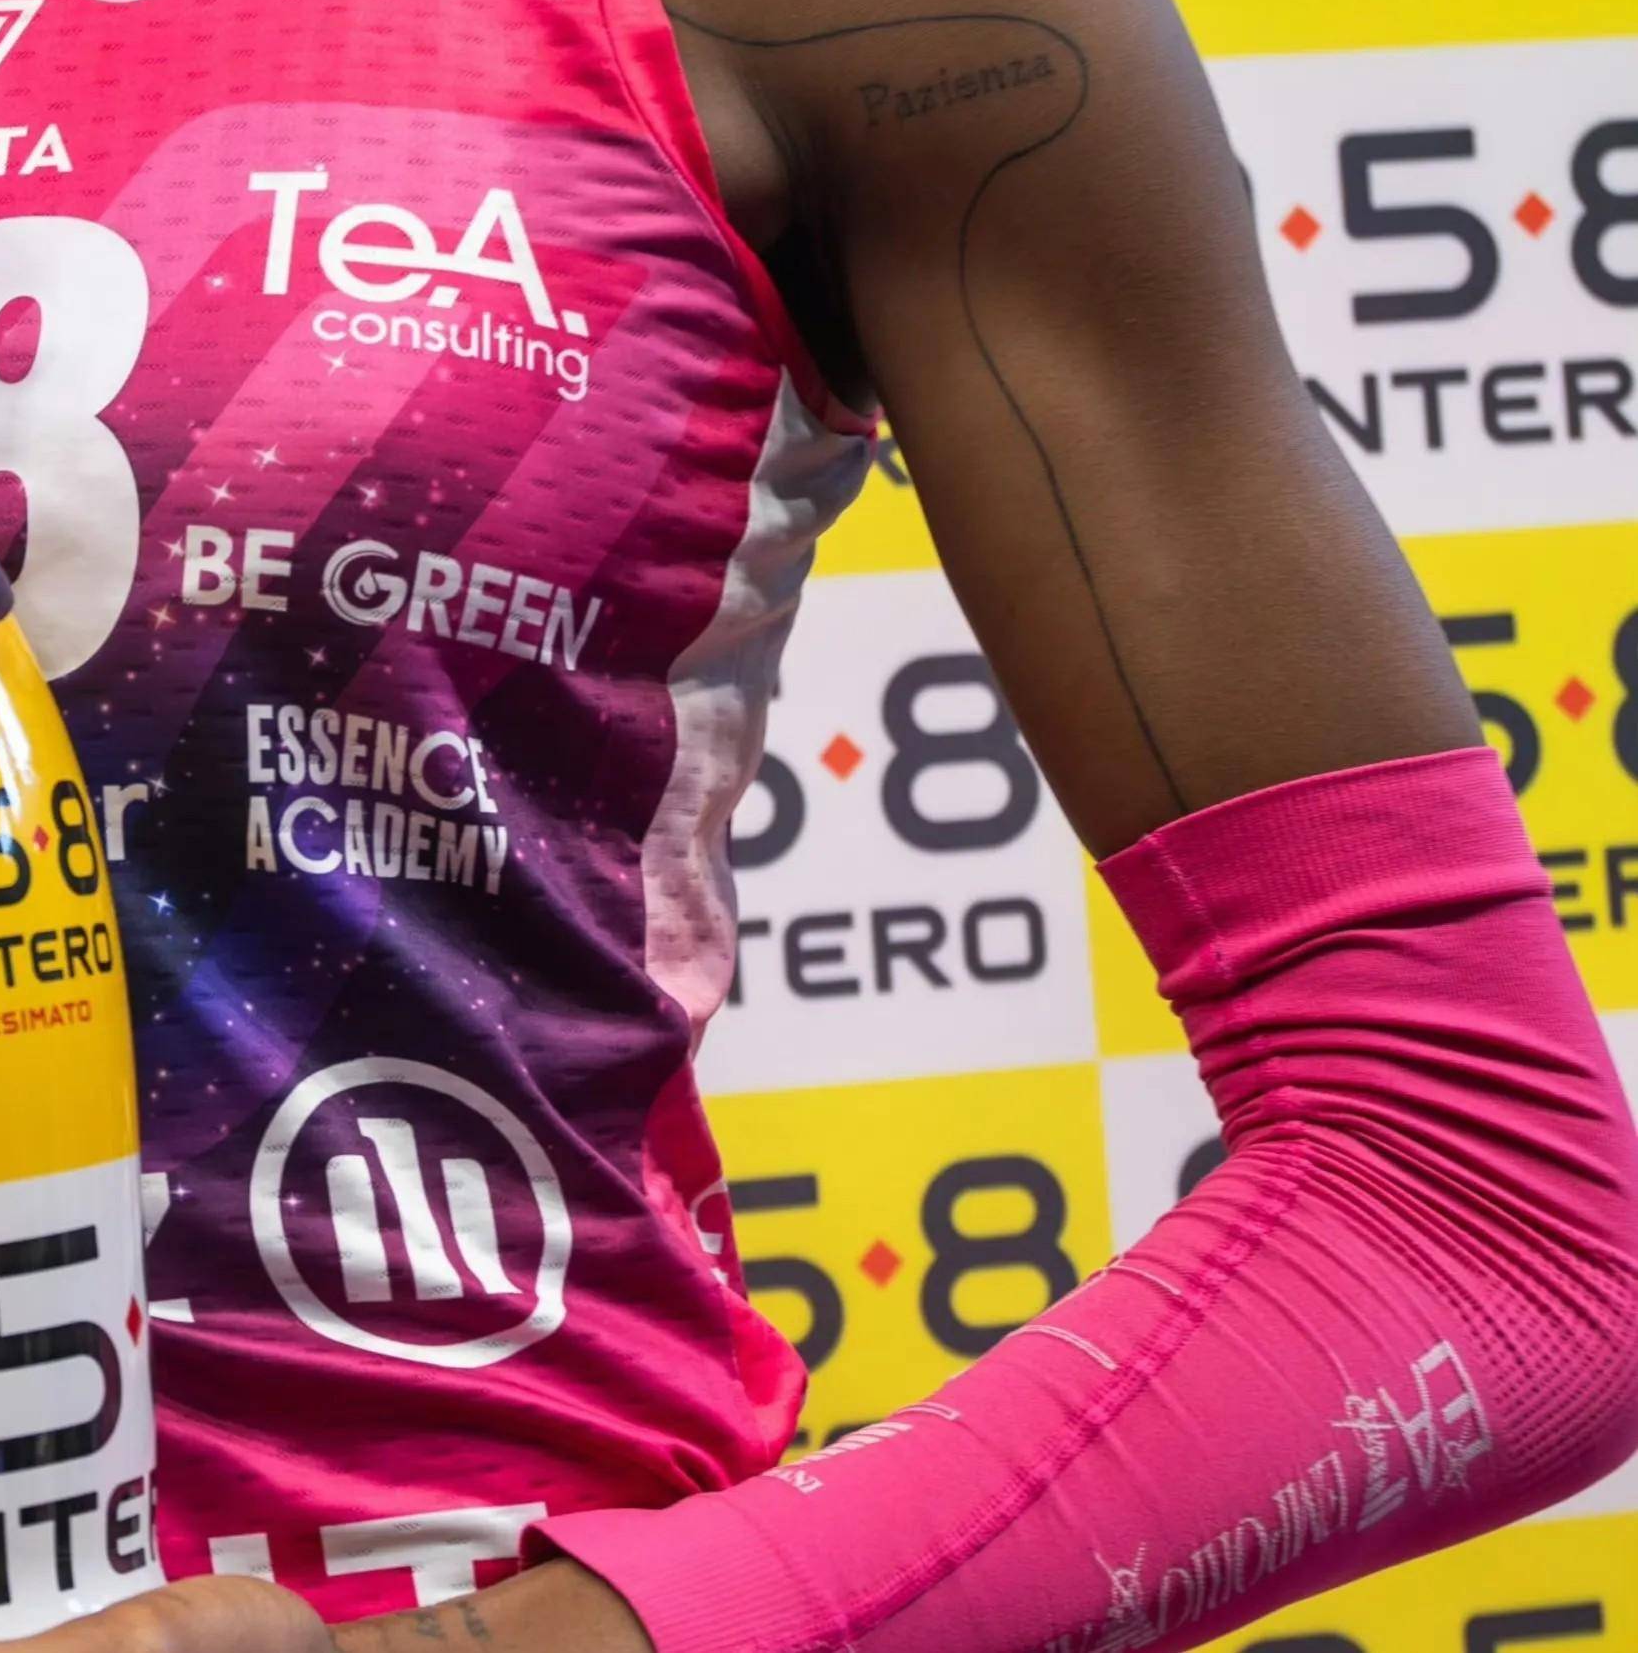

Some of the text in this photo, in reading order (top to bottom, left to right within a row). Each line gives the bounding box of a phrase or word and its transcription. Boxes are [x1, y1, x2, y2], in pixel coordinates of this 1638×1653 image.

[858, 53, 1057, 129] Pazienza
[311, 307, 591, 402] consulting
[179, 523, 603, 672] BE GREEN
[246, 703, 499, 815] ESSENCE
[245, 794, 509, 896] ACADEMY
